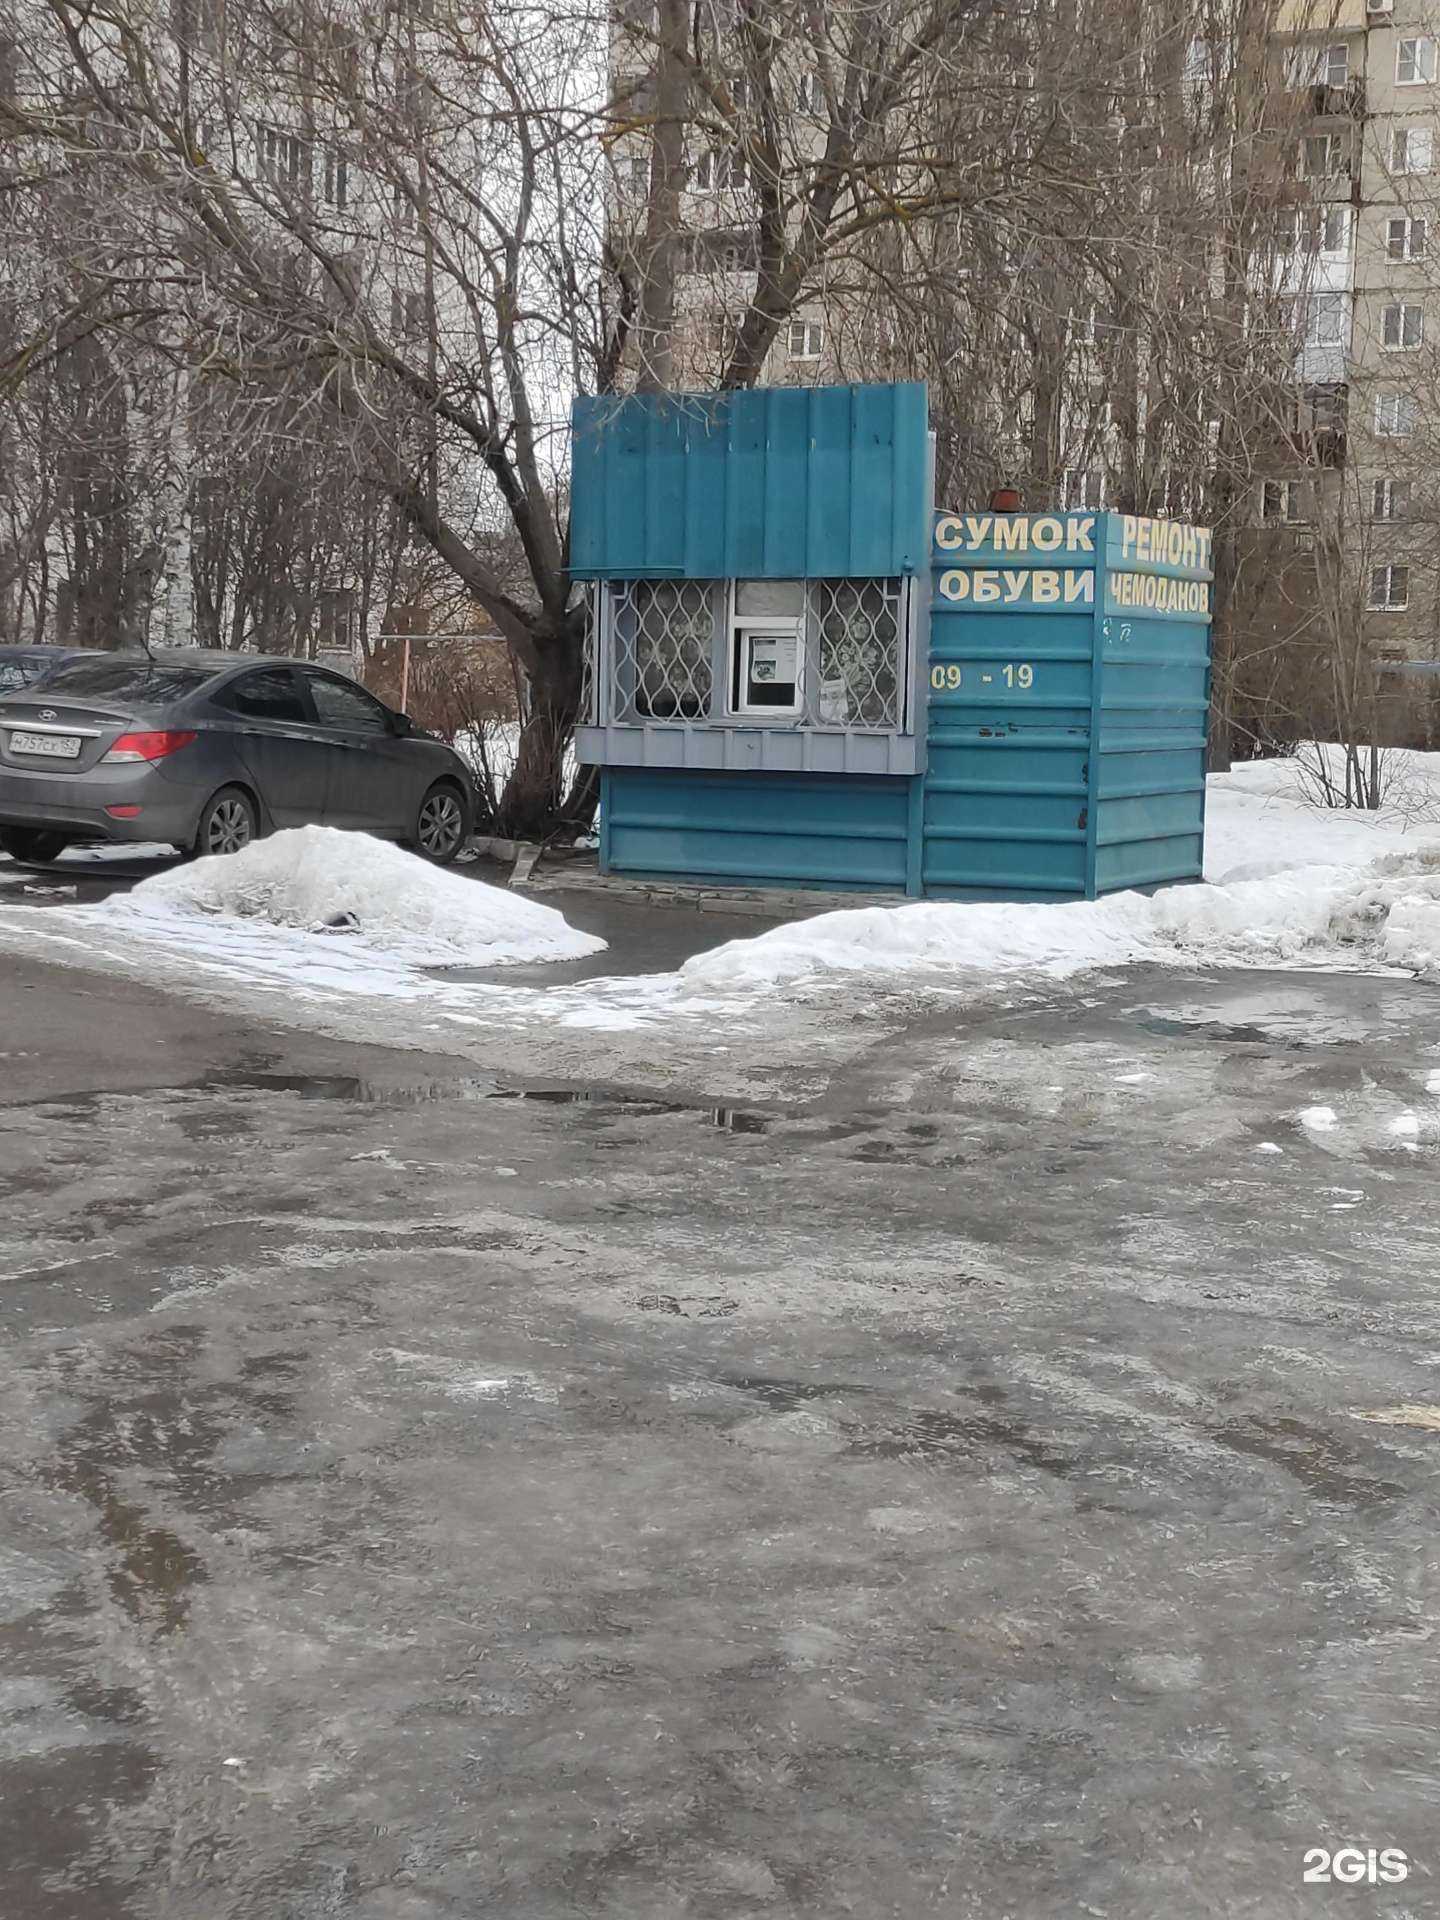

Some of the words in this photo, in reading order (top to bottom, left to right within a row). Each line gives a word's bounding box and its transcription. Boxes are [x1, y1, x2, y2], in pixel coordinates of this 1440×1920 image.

[935, 516, 1095, 551] СУМОК
[1121, 515, 1211, 569] РЕМОНТ
[939, 570, 1094, 602] ОБУВИ
[1111, 572, 1209, 613] ЧЕМОДАНОВ
[931, 665, 961, 689] 09
[1002, 664, 1033, 688] 19
